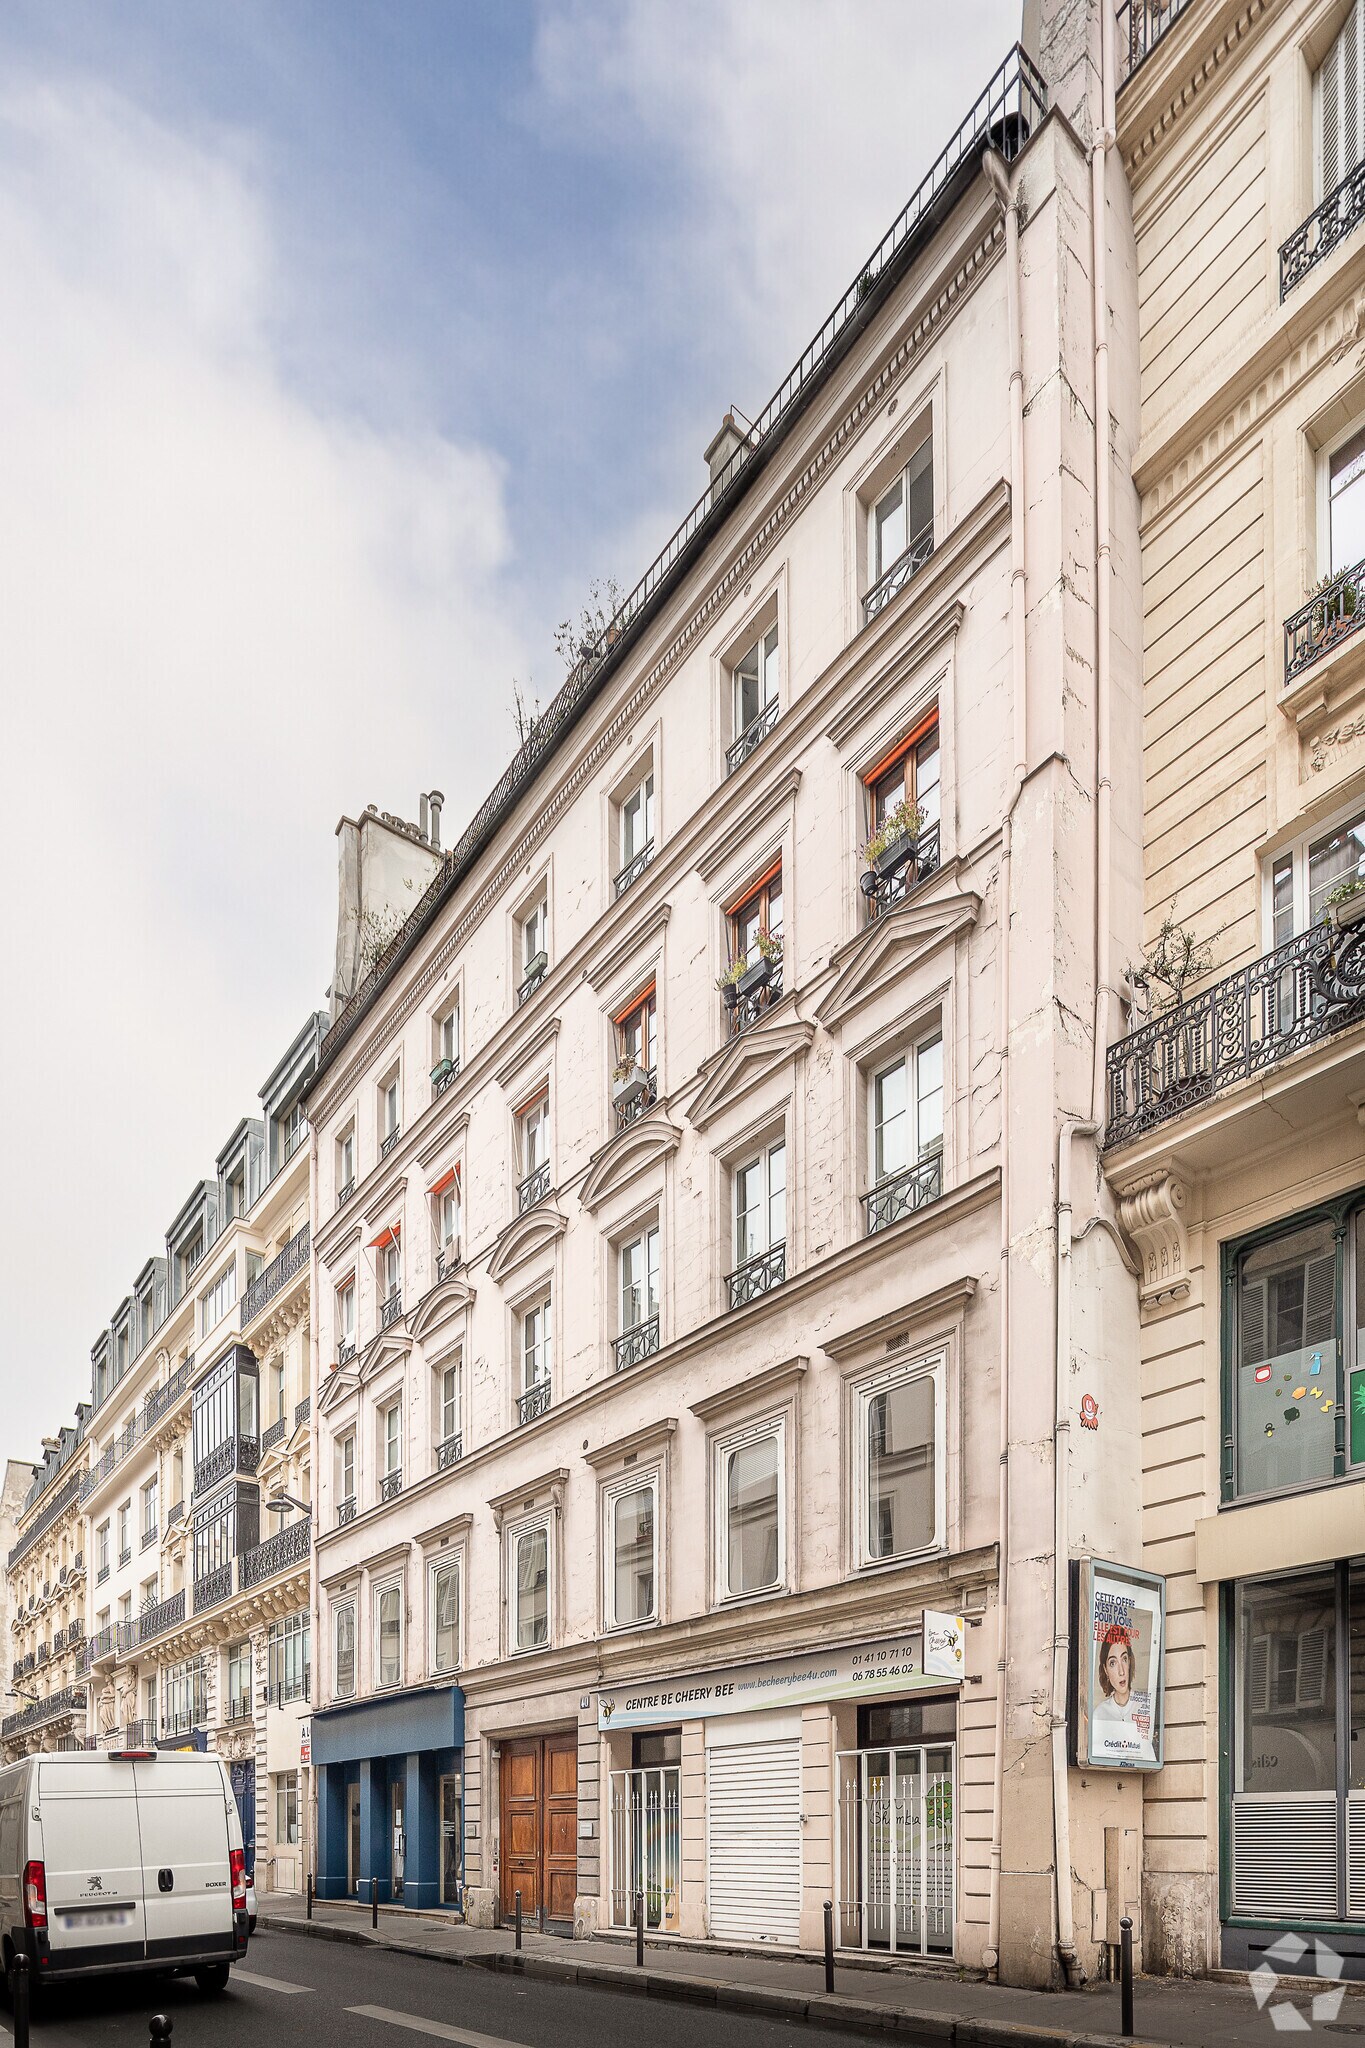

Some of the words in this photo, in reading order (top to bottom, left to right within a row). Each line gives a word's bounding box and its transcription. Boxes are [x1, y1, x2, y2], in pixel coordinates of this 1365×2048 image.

[1095, 1591, 1115, 1605] CETTE
[1116, 1596, 1136, 1609] OFFRE
[1095, 1601, 1113, 1614] N'EST
[1114, 1605, 1128, 1617] PAS
[1094, 1611, 1113, 1624] POUR
[1094, 1621, 1109, 1633] ELLE
[1110, 1624, 1122, 1635] EST
[1093, 1631, 1106, 1642] LES
[852, 1655, 862, 1665] 01
[864, 1653, 875, 1664] 41
[876, 1651, 887, 1661] 10
[889, 1648, 899, 1659] 71
[901, 1646, 912, 1657] 10
[852, 1672, 863, 1682] 06
[864, 1669, 875, 1679] 78
[876, 1667, 888, 1678] 55
[889, 1665, 900, 1675] 46
[901, 1663, 914, 1674] 02
[625, 1695, 659, 1711] CENTRE
[661, 1693, 673, 1706] BE
[675, 1687, 712, 1703] CHEERY
[715, 1683, 735, 1698] BEE
[737, 1668, 838, 1691] www.becheerybee4u.com
[581, 1696, 589, 1708] 40
[1104, 1740, 1122, 1749] Crédit
